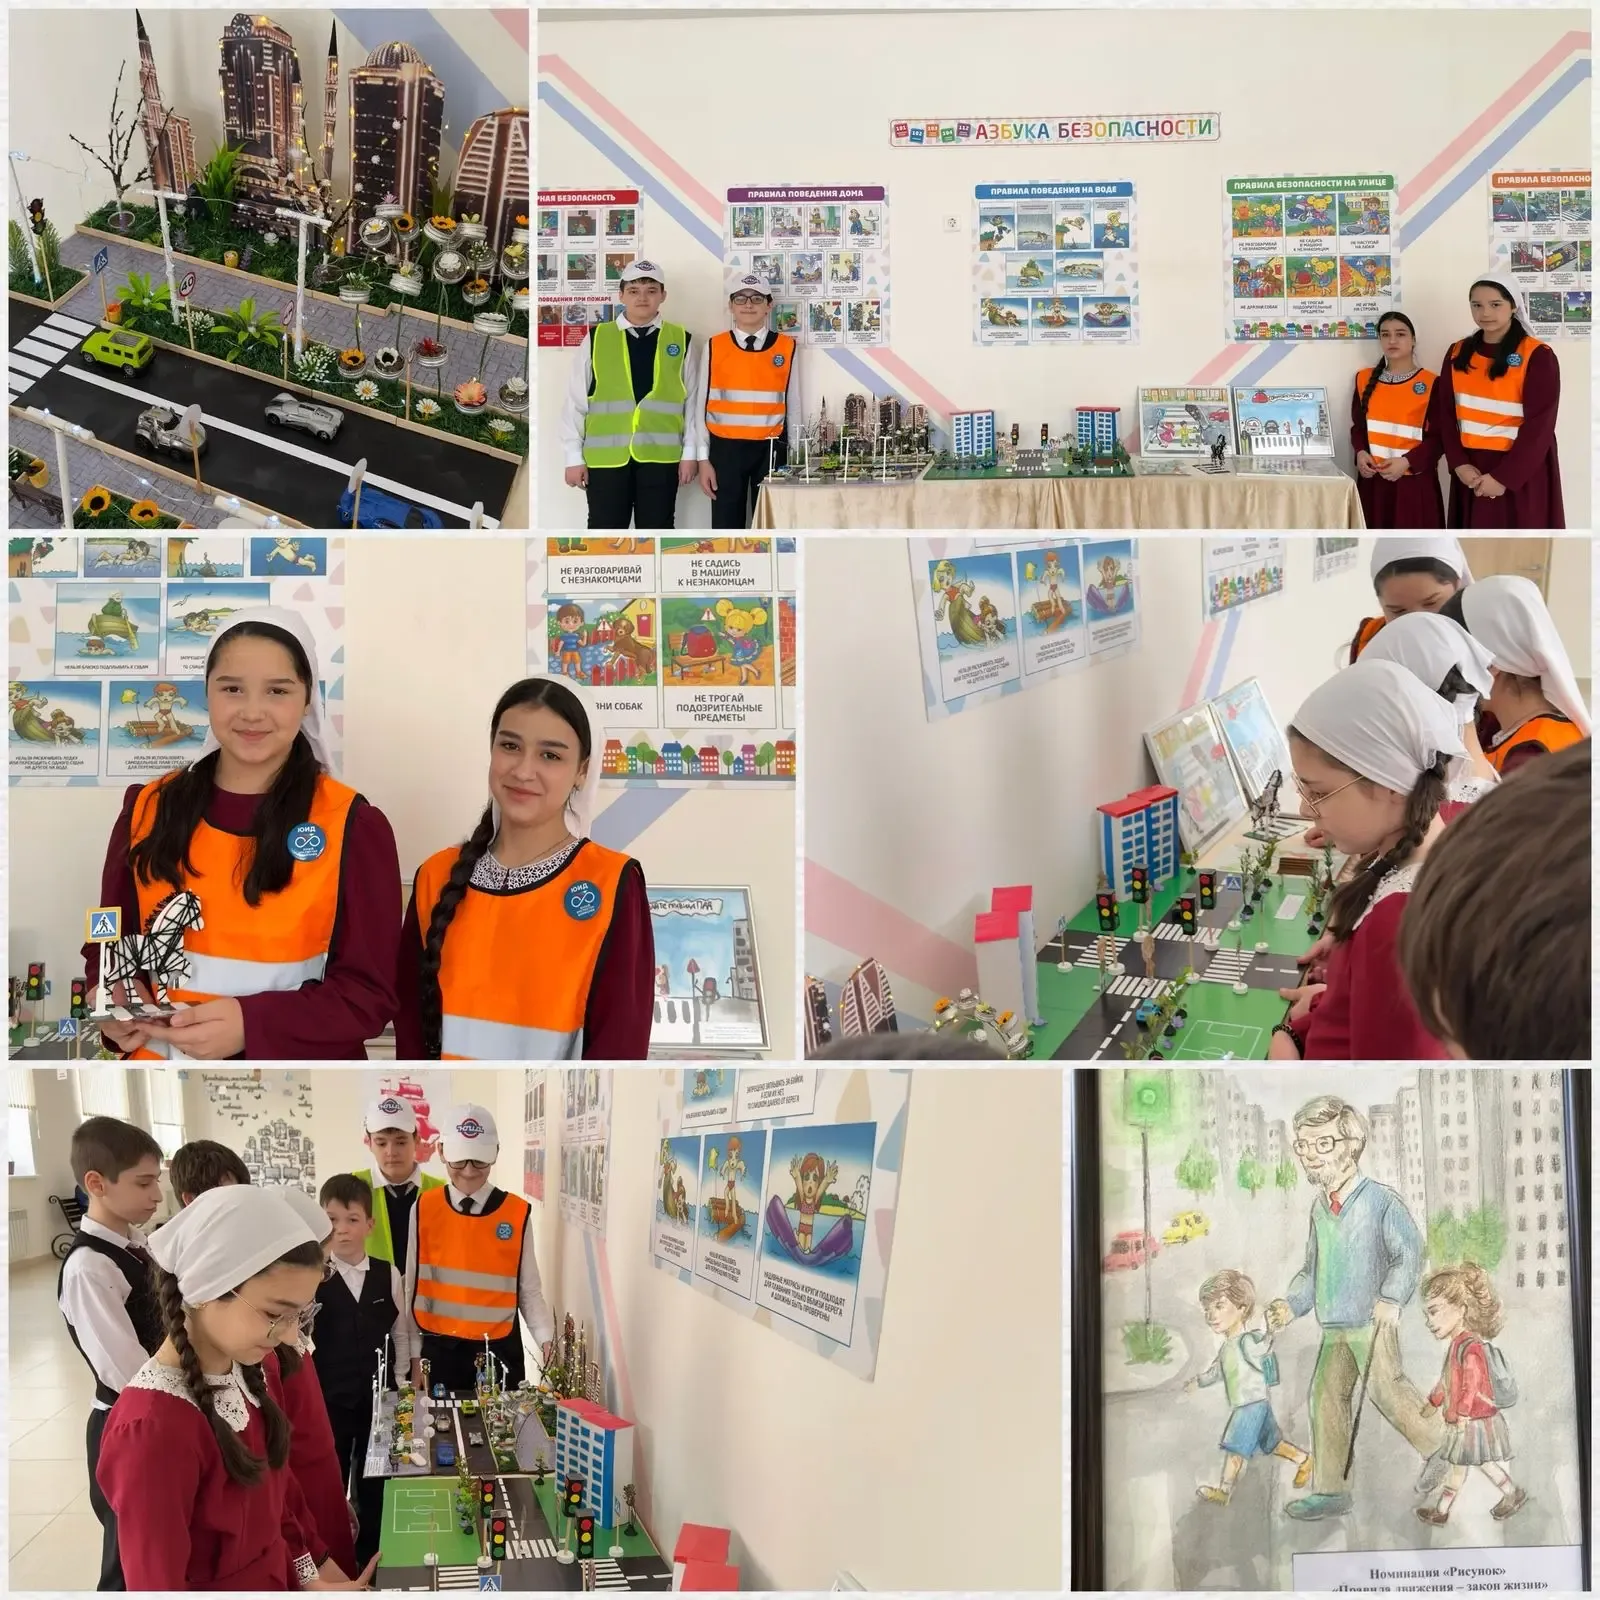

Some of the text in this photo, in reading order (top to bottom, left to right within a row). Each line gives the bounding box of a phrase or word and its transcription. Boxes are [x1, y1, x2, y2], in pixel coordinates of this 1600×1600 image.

[976, 119, 1212, 139] АЗБУКА БЕЗОПАСНОСТИ
[1276, 180, 1342, 188] БЕЗОПАСНОСТИ
[1358, 178, 1387, 186] УЛИЦЕ
[182, 277, 193, 291] 40
[705, 560, 741, 568] САДИСЬ
[574, 565, 642, 574] РАЗГОВАРИВАЙ
[568, 576, 641, 584] НЕЗНАКОМЦАМИ
[686, 578, 755, 586] НЕЗНАКОМЦАМ
[709, 693, 744, 702] ТРОГАЙ
[614, 702, 643, 710] СОБАК
[677, 704, 763, 712] ПОДОЗРИТЕЛЬНЫЕ
[694, 714, 745, 722] ПРЕДМЕТЫ
[571, 883, 588, 892] ЮИД
[819, 1290, 845, 1307] ПОДХОДЯТ
[1370, 1567, 1506, 1579] Номинация «Рисунок»
[1467, 1582, 1500, 1591] закон
[1504, 1581, 1548, 1590] жизни»
